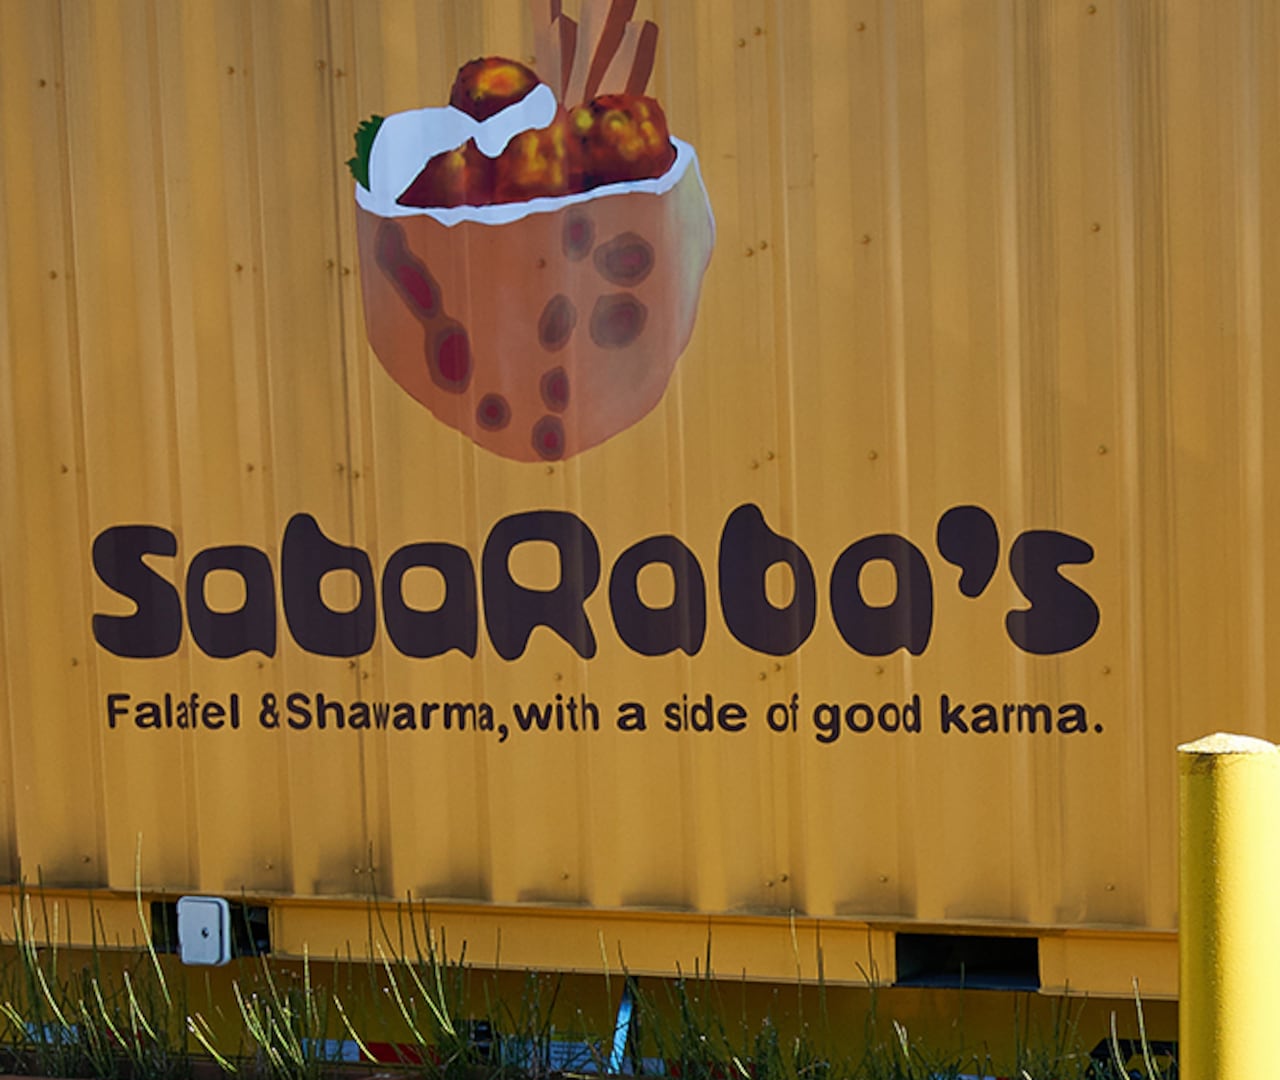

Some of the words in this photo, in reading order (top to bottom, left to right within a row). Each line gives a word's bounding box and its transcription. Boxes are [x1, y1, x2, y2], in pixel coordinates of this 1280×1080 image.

[106, 693, 240, 730] Falafel
[616, 702, 647, 731] a
[664, 694, 748, 732] side
[766, 693, 799, 732] of
[813, 694, 922, 743] good
[940, 694, 1104, 734] karma.
